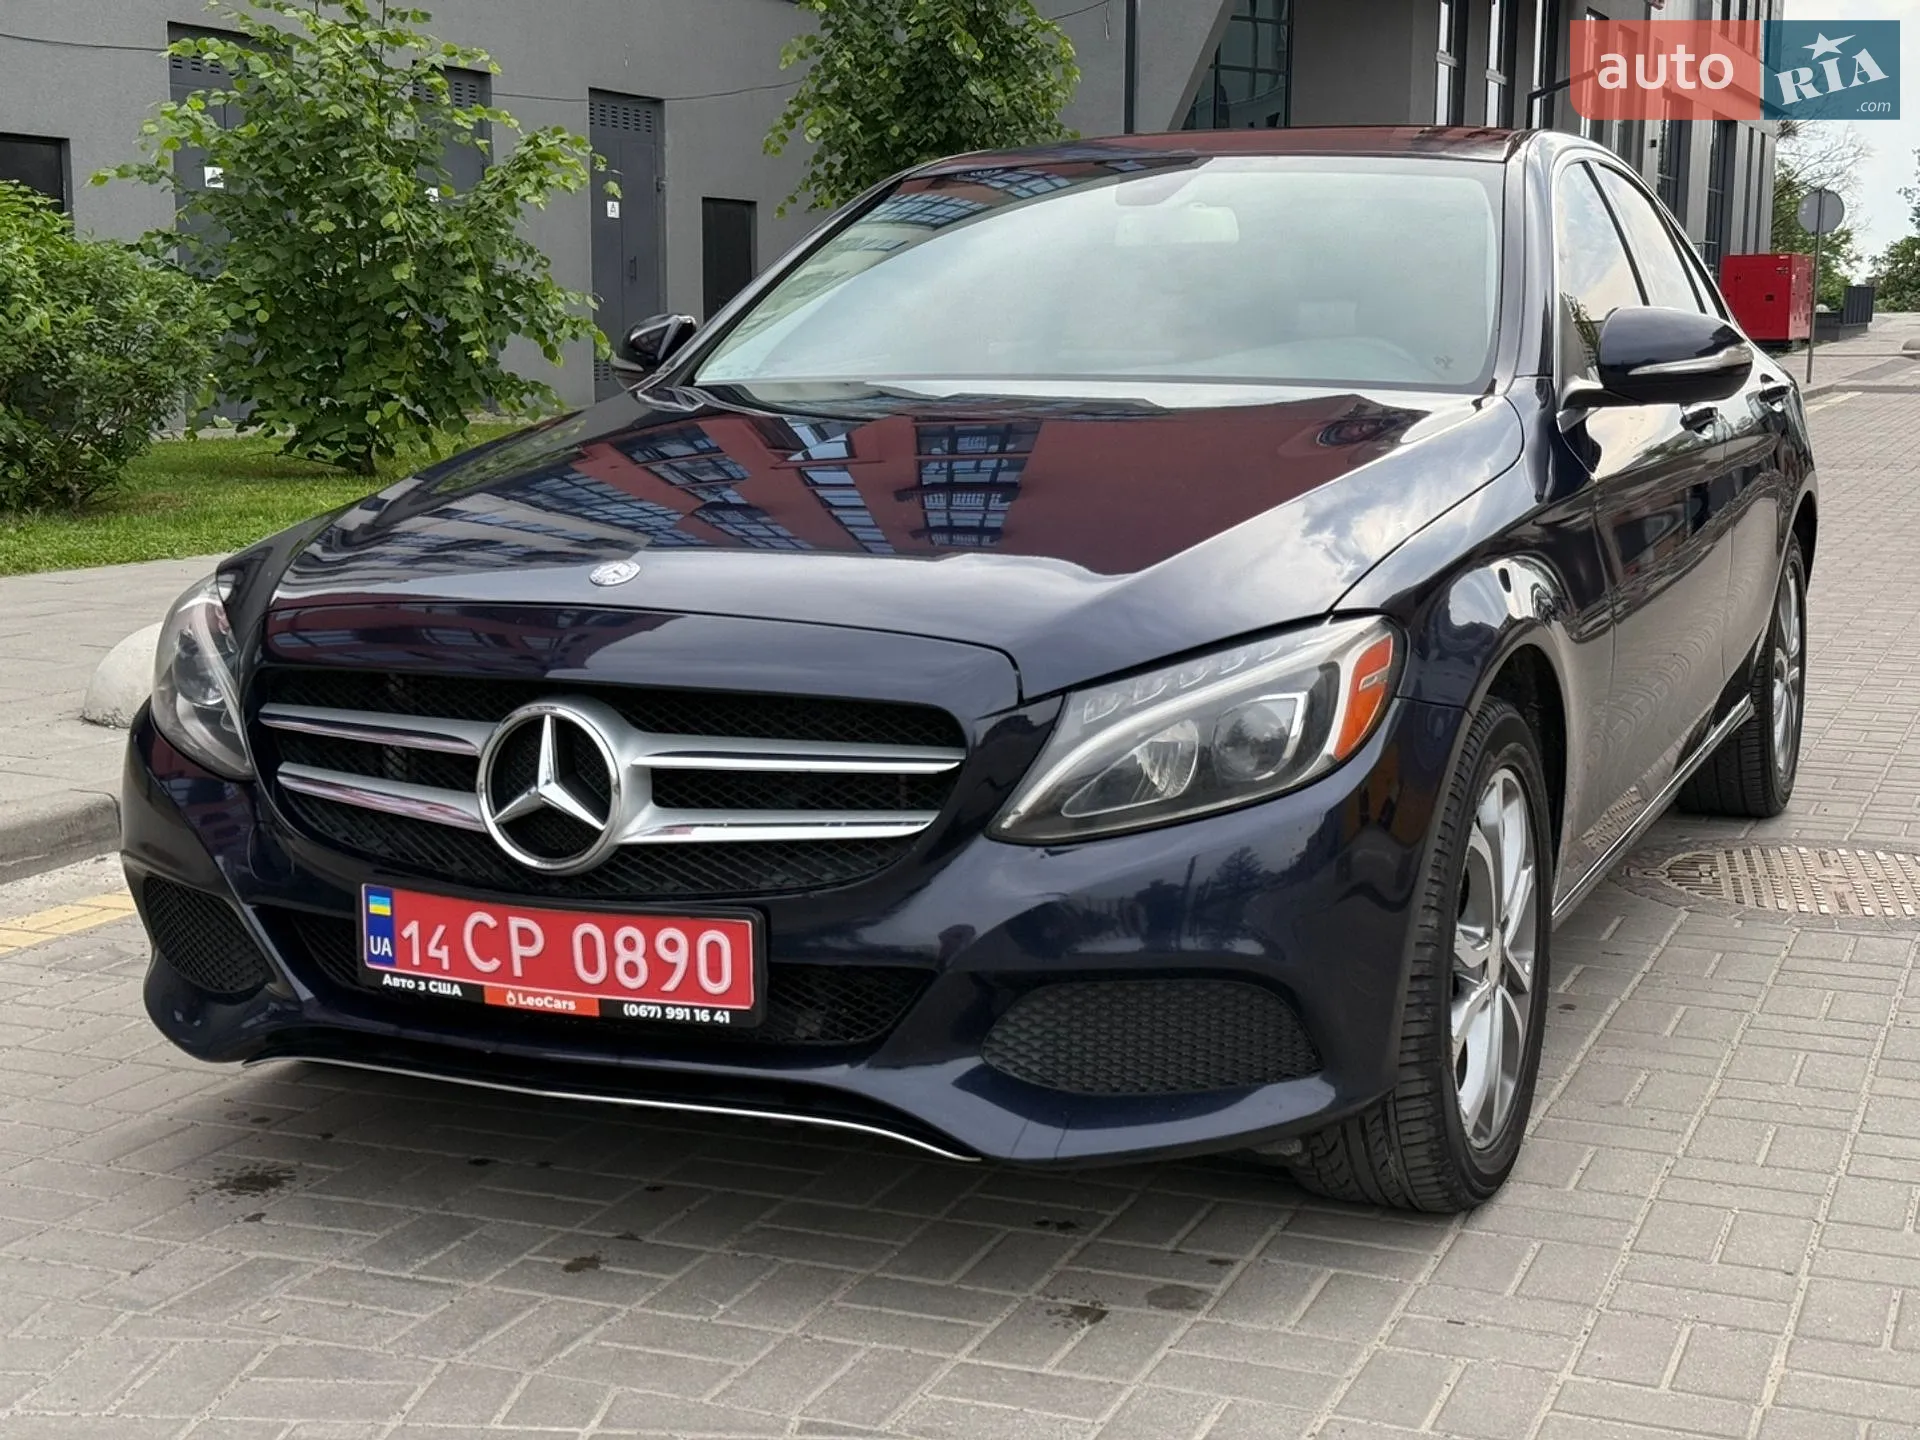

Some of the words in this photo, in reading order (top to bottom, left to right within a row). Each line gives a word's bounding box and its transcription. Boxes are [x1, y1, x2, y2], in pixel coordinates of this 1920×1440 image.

[369, 935, 393, 957] UA
[401, 920, 450, 971] 14
[463, 911, 545, 977] CP
[572, 922, 732, 995] 0890
[428, 981, 462, 996] США
[518, 994, 576, 1011] LeoCars
[622, 1003, 662, 1019] (067)
[665, 1006, 691, 1021] 991
[694, 1008, 711, 1023] 16
[713, 1010, 731, 1024] 41
